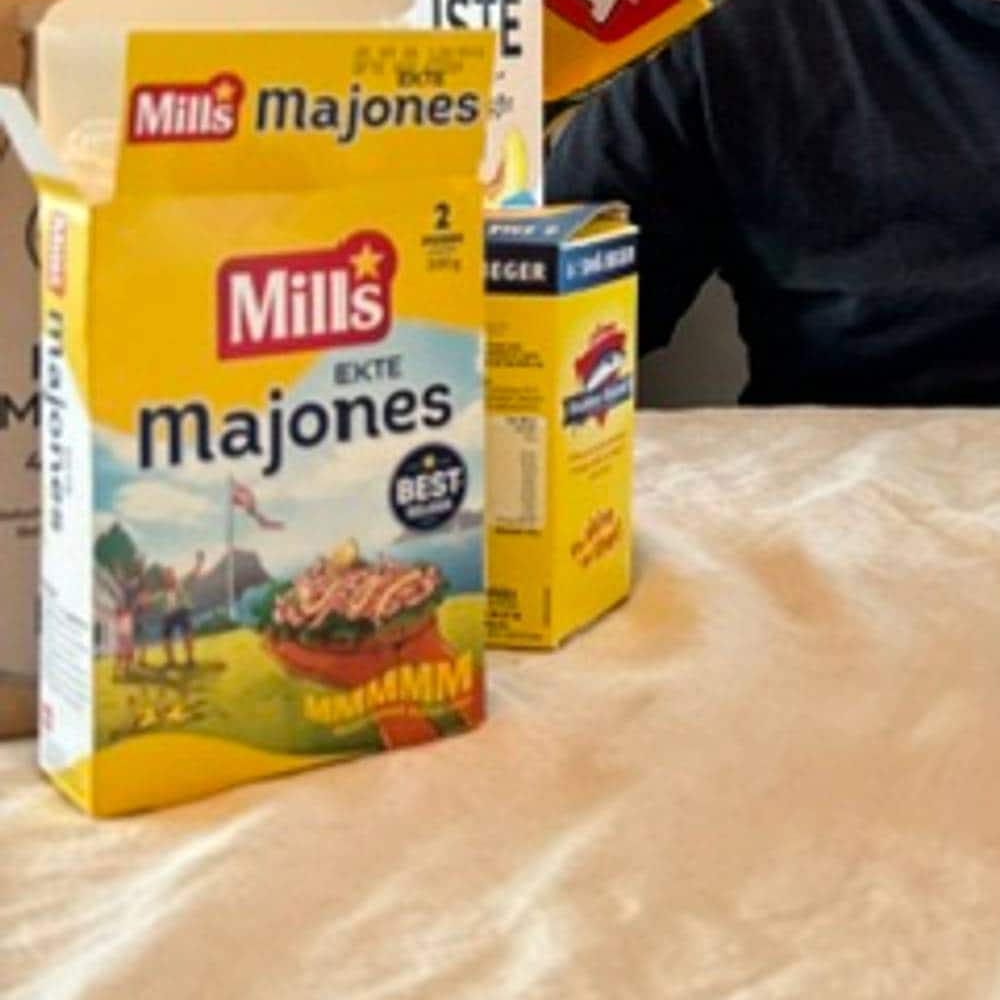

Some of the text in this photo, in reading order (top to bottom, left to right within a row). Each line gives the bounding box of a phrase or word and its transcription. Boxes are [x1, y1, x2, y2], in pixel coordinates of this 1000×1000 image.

[134, 91, 235, 137] Mills
[256, 83, 481, 143] majones
[432, 203, 451, 229] 2
[484, 261, 547, 281] EGER
[228, 267, 386, 345] Mills
[334, 354, 403, 386] EKTE
[138, 384, 453, 478] majones
[396, 467, 460, 505] BEST
